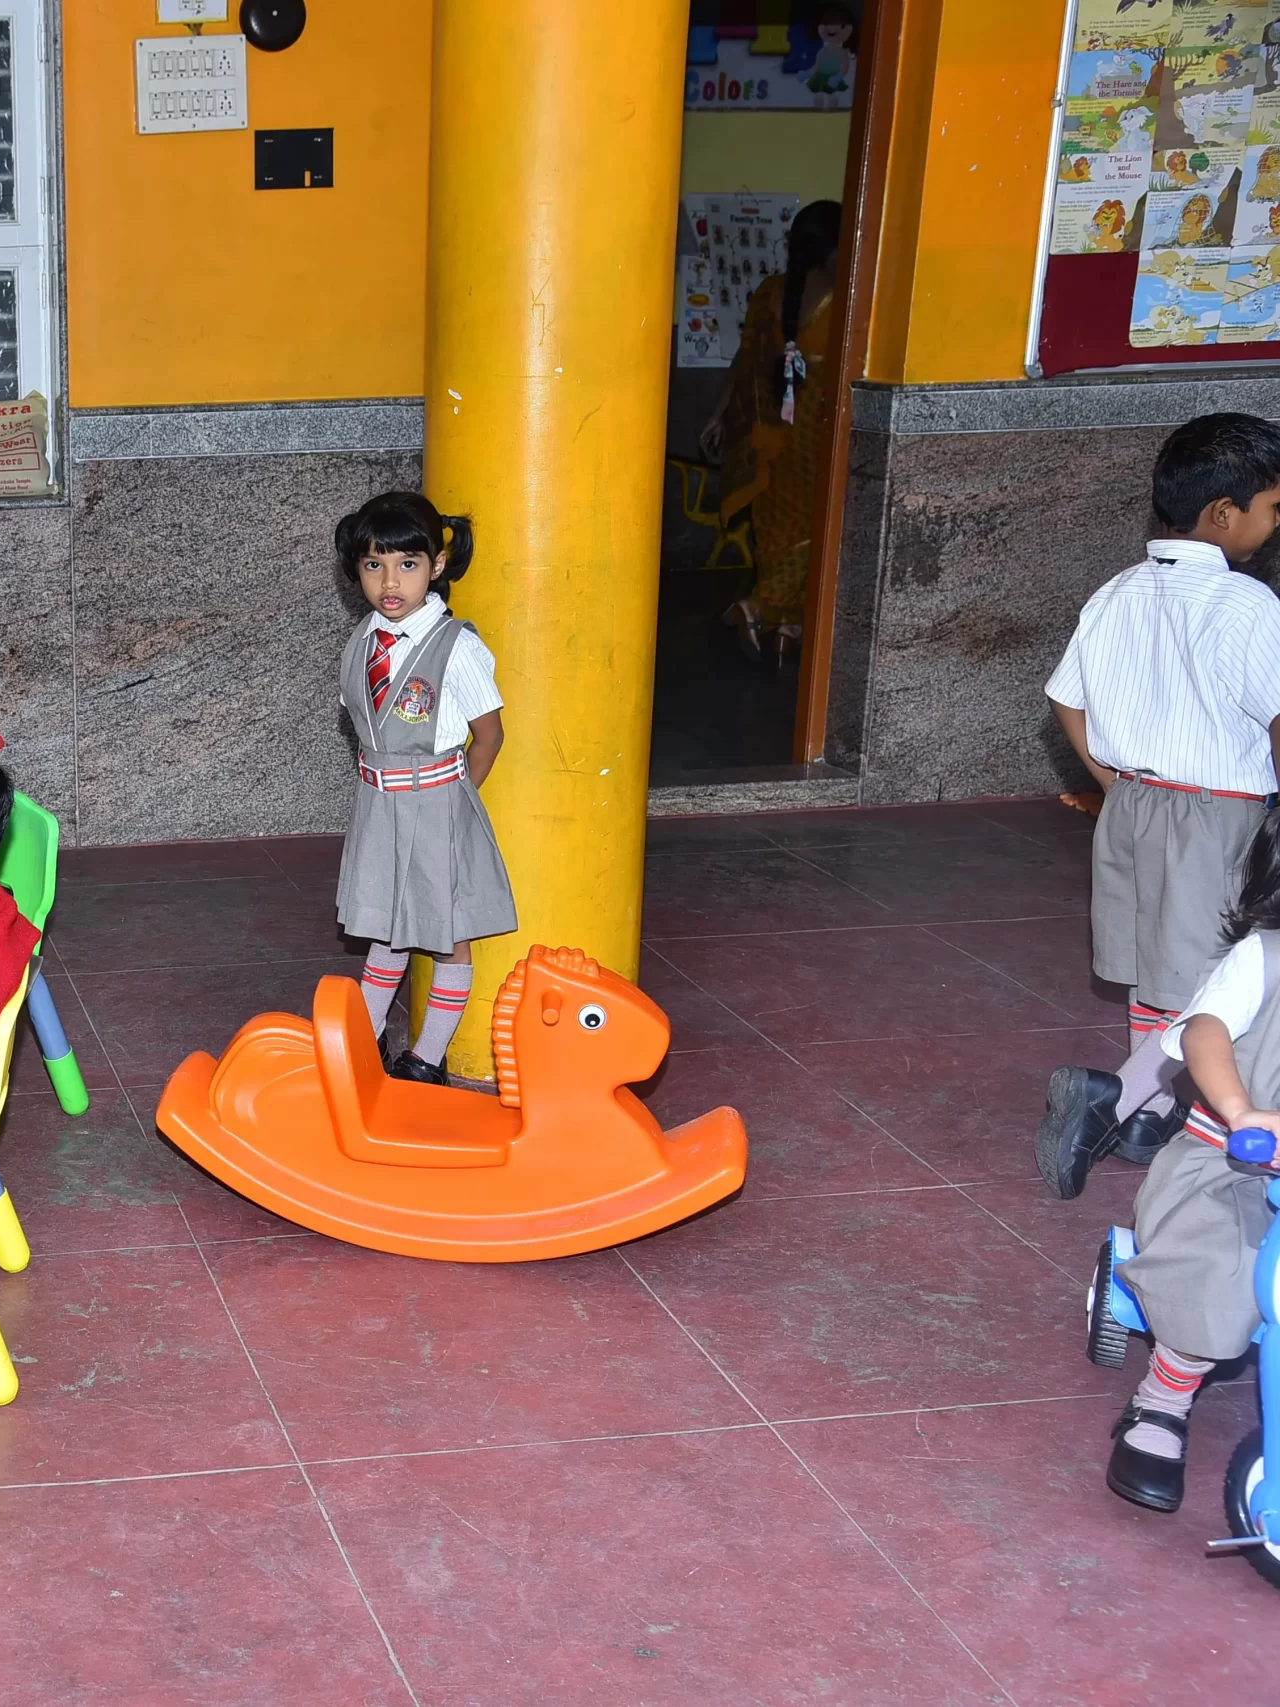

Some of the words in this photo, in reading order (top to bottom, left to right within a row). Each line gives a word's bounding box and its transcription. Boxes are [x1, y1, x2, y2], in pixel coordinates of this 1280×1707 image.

[686, 69, 769, 102] Colors
[1095, 81, 1111, 89] The
[1112, 80, 1132, 88] Hare
[1133, 79, 1147, 87] and
[1098, 90, 1111, 98] the
[1112, 89, 1142, 97] Tortoise
[1107, 155, 1123, 163] The
[1117, 172, 1142, 180] Mouse
[729, 214, 754, 226] Family
